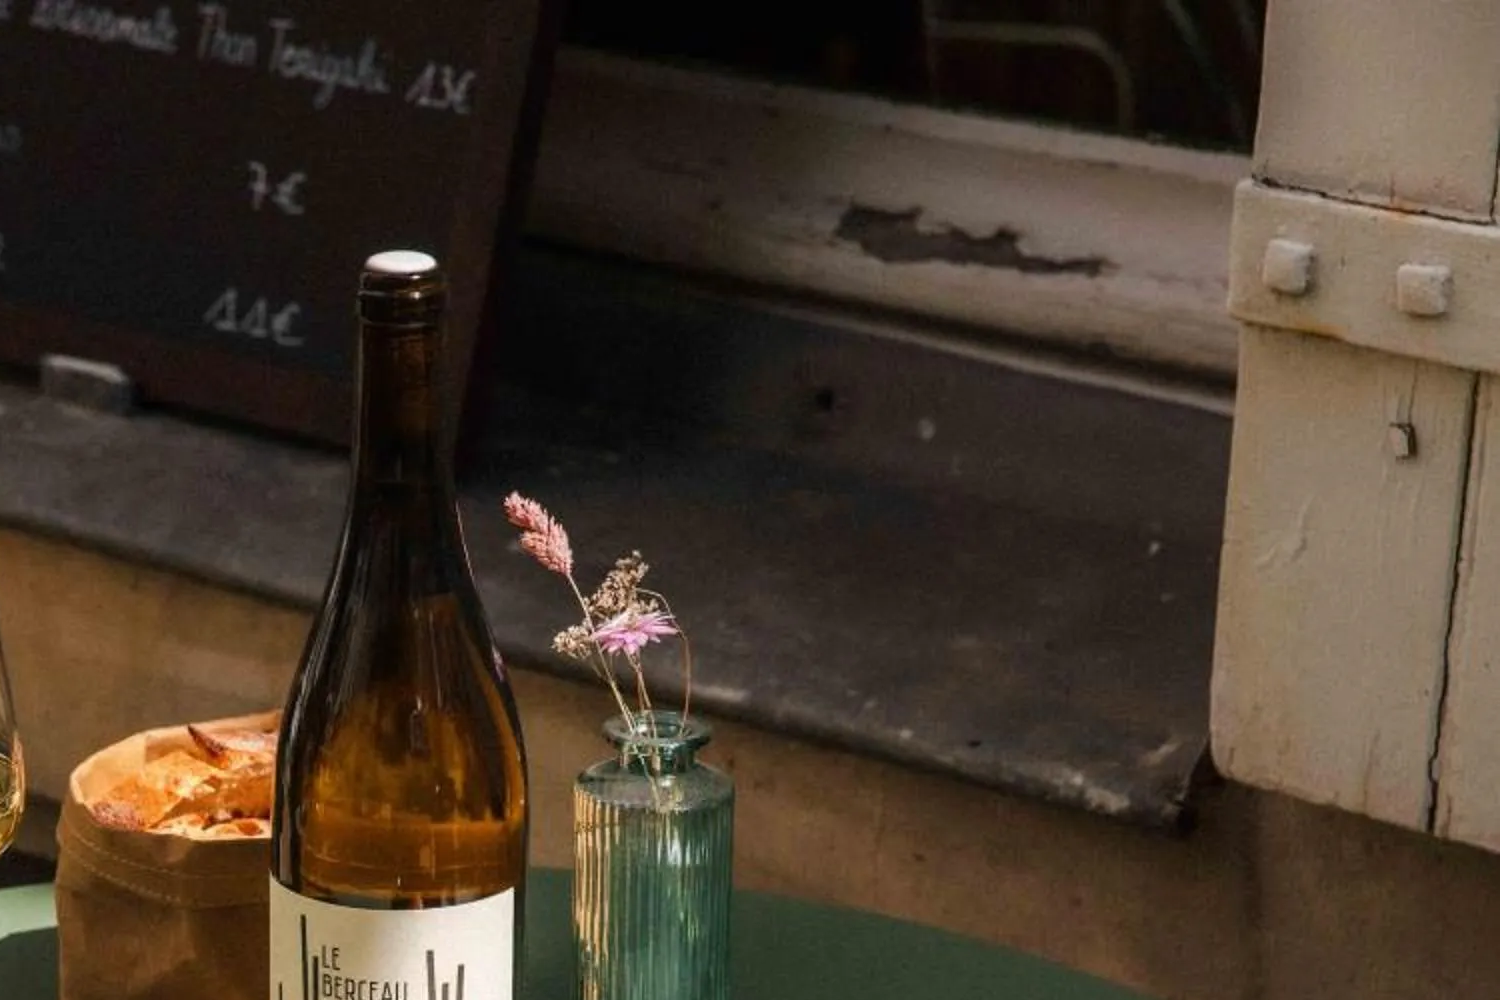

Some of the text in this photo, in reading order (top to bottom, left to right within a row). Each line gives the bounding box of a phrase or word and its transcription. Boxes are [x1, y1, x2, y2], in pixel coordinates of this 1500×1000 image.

[247, 160, 308, 215] 7€
[203, 287, 304, 347] 11€
[321, 945, 340, 971] LE
